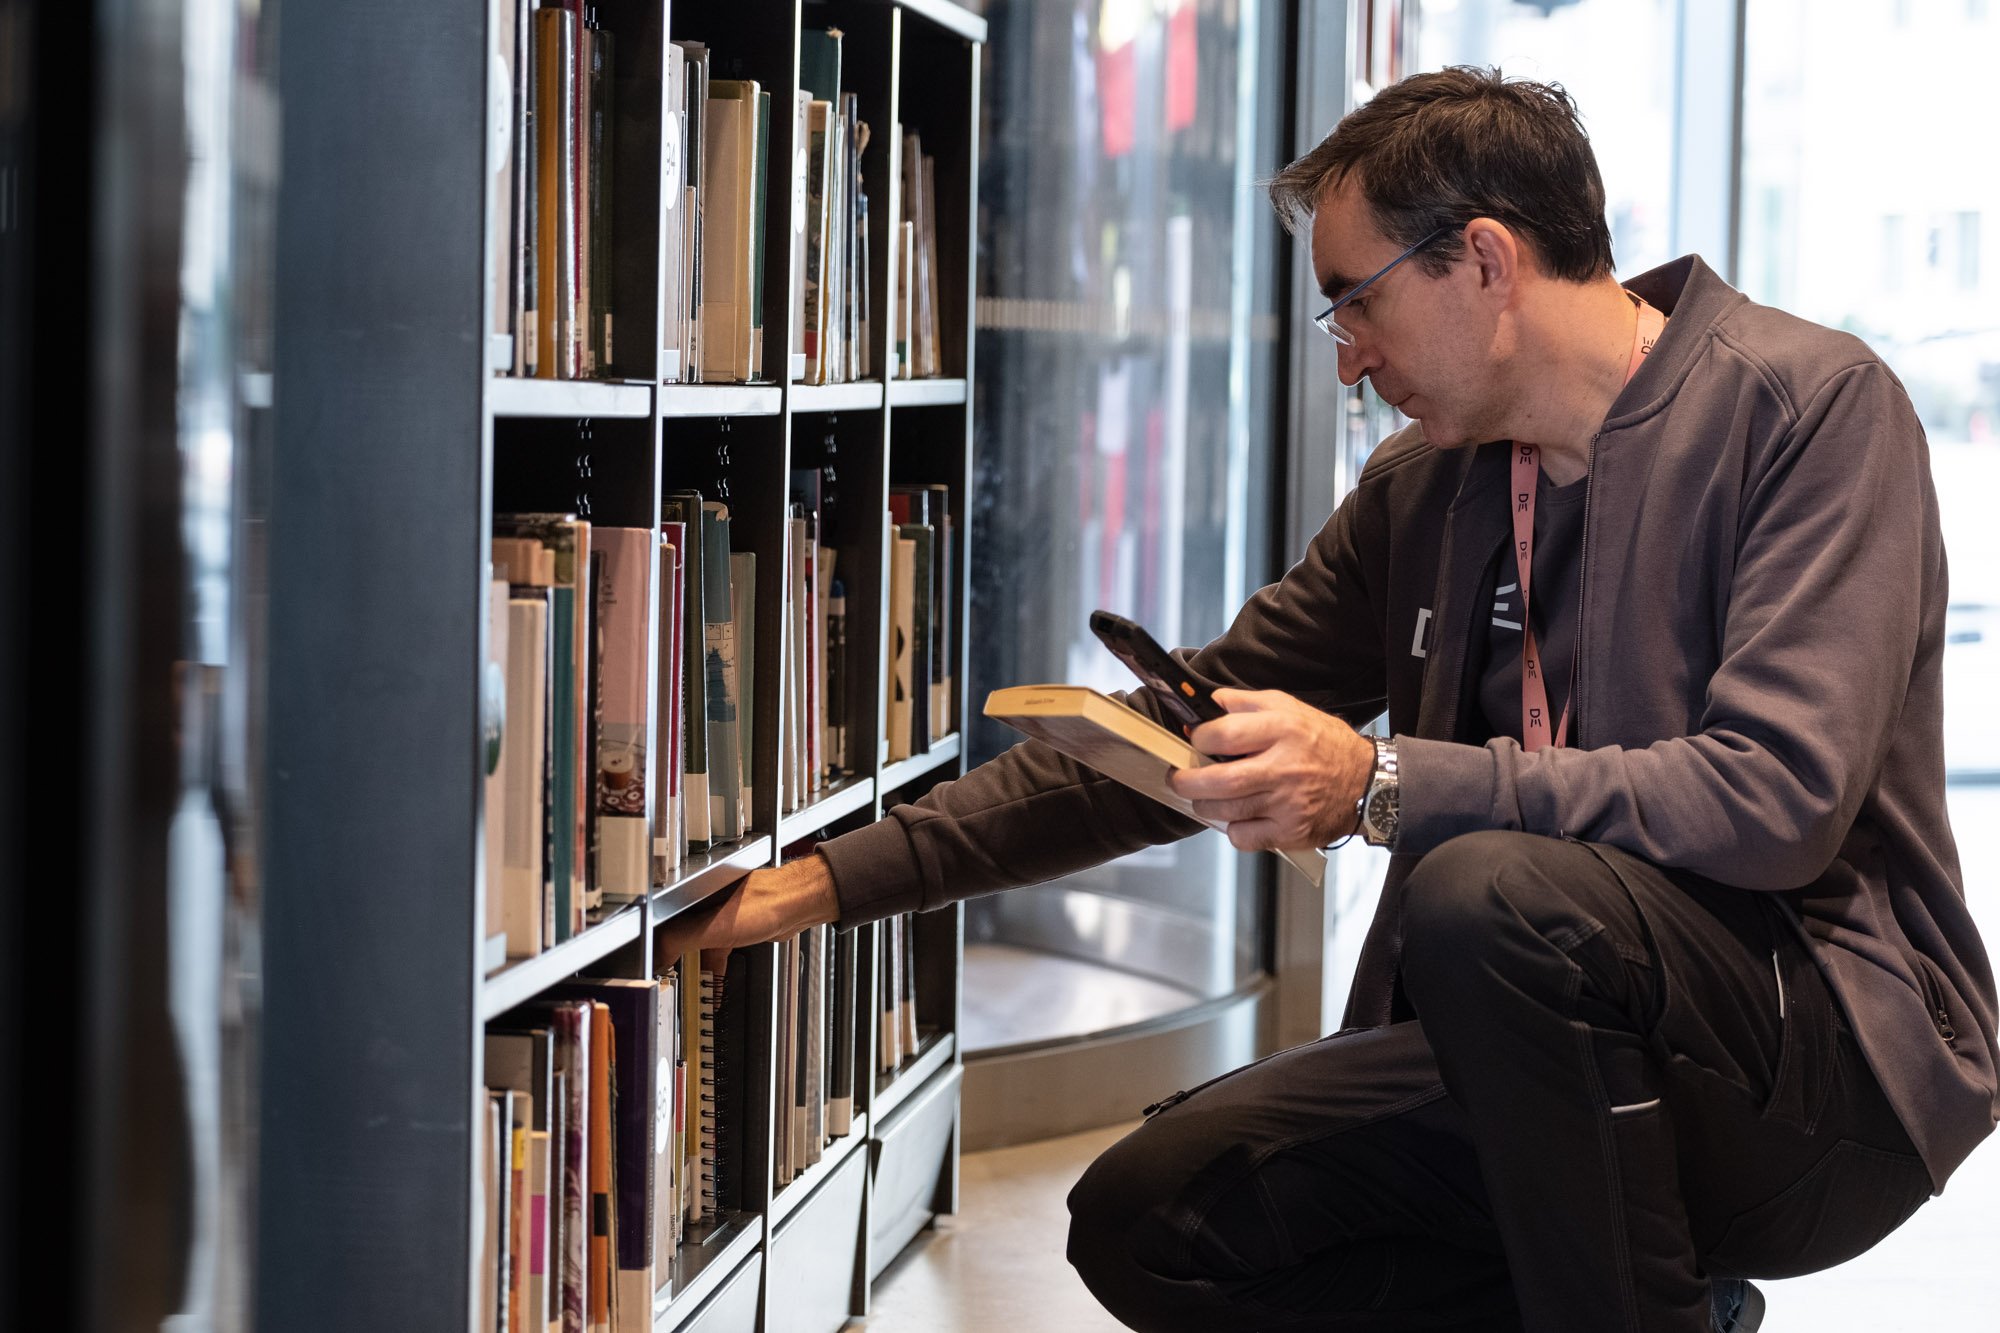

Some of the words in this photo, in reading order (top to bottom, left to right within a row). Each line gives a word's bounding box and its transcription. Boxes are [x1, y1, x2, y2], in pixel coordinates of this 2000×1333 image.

[1519, 446, 1533, 465] DE
[1518, 493, 1529, 512] DE
[1519, 541, 1528, 560] DE
[1527, 660, 1537, 679] DE
[1529, 708, 1541, 728] DE
